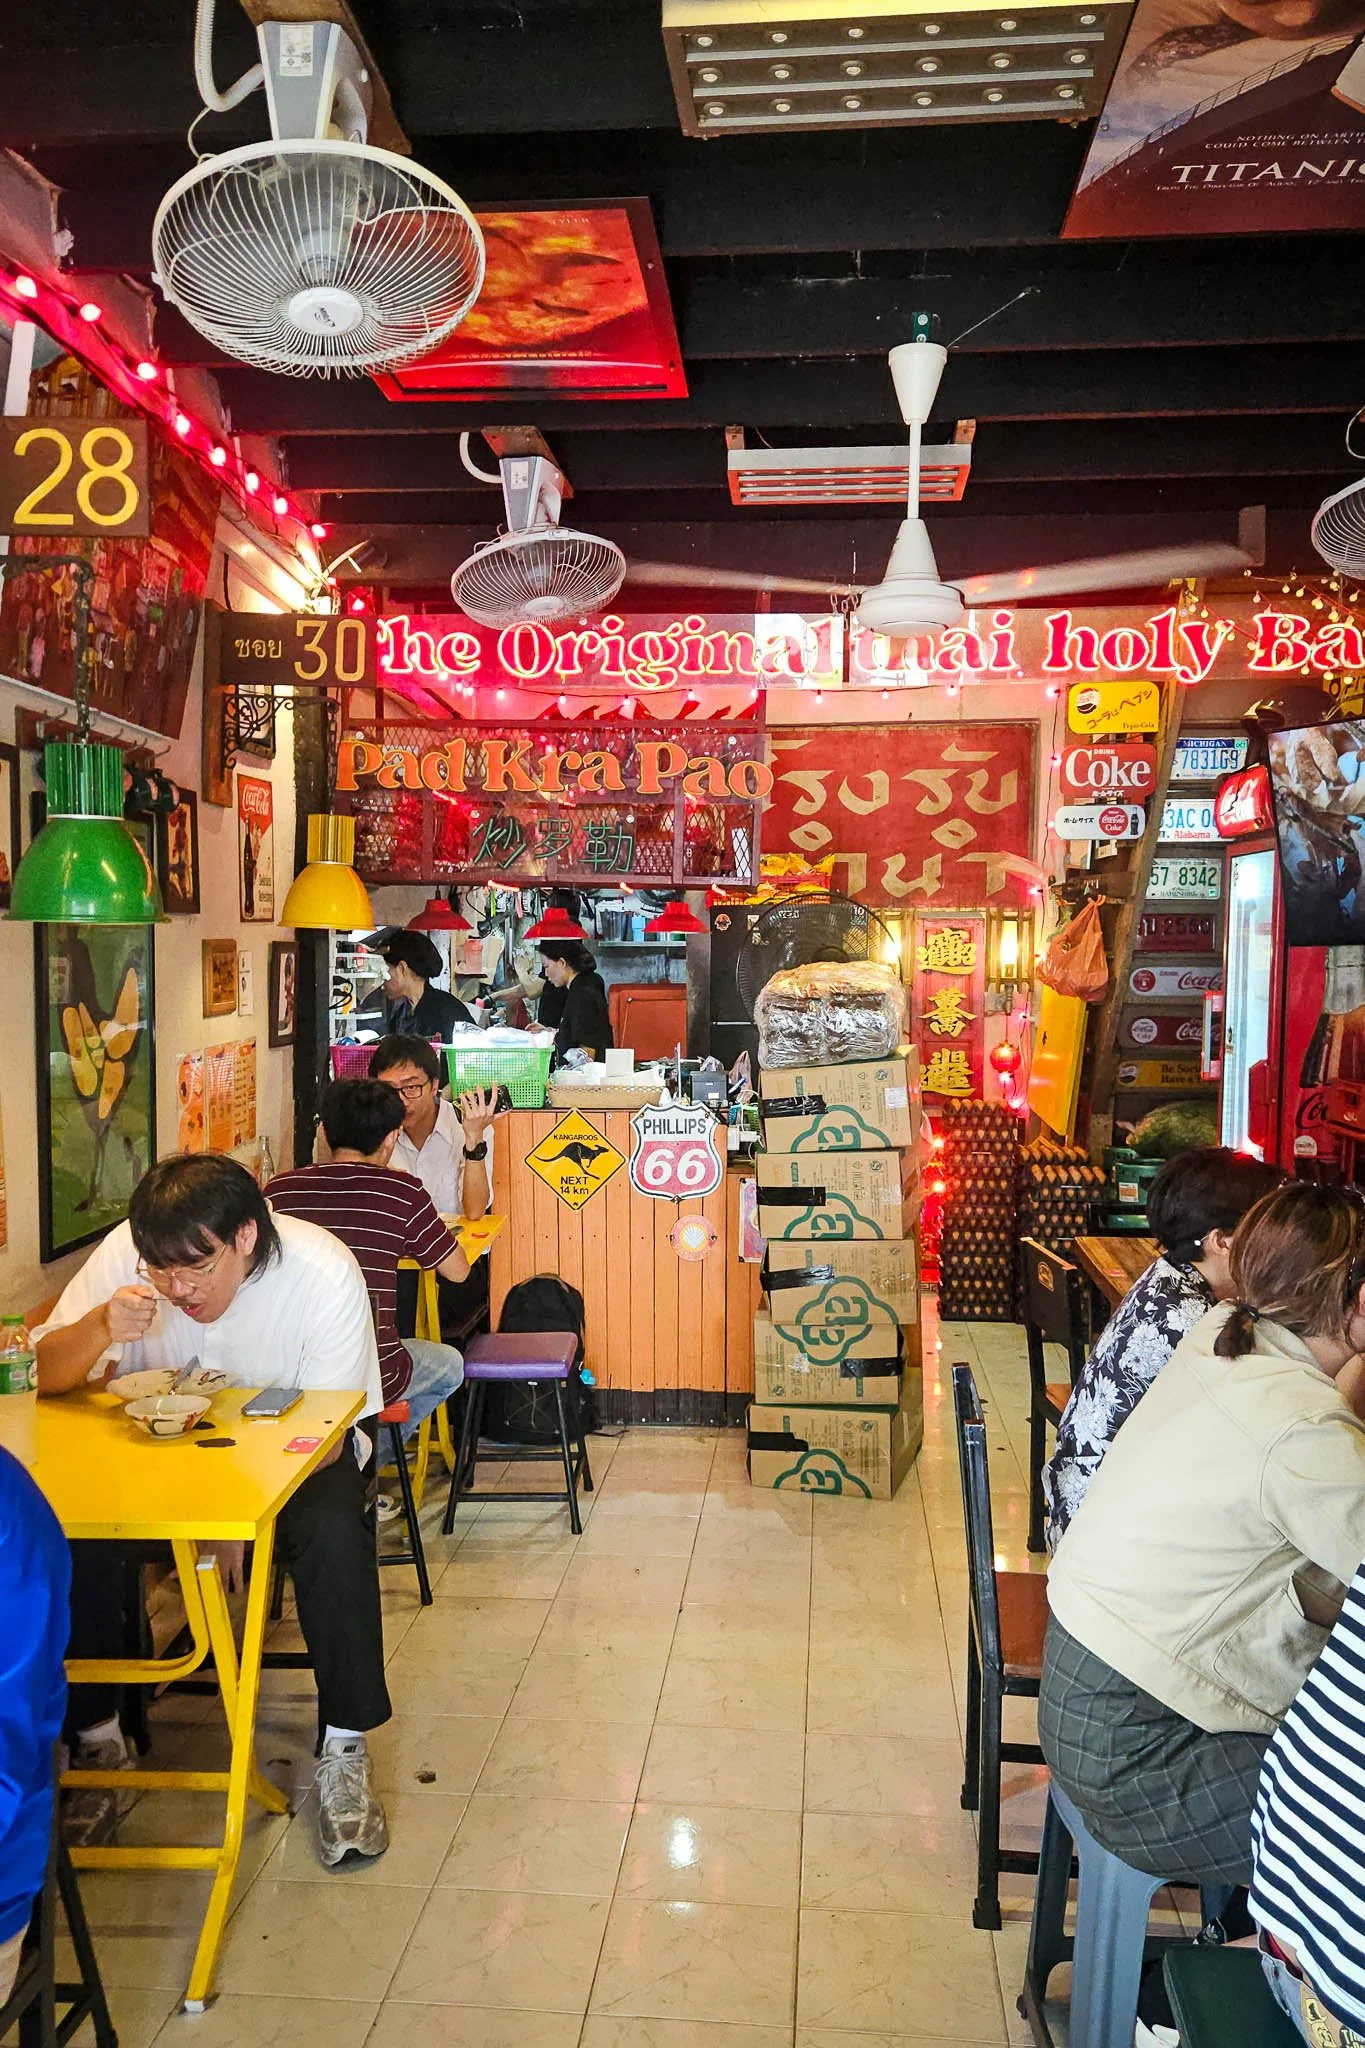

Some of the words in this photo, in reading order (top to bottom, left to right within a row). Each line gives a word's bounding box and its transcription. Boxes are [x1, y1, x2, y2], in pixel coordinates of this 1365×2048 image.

[13, 427, 139, 526] 28
[235, 638, 282, 659] ซอย
[294, 619, 366, 681] 30
[376, 614, 482, 675] he
[497, 614, 838, 689] Original
[1042, 607, 1235, 683] holy
[1182, 740, 1227, 748] MICHIGAN
[335, 738, 467, 792] Pad
[482, 740, 626, 792] Kra
[635, 742, 774, 799] Pao
[1065, 749, 1151, 787] Coke
[1160, 808, 1196, 829] 3AC
[472, 817, 633, 873] 炒罗勒
[1173, 830, 1211, 839] Alabama
[1179, 866, 1218, 887] 8342
[643, 1117, 707, 1135] PHILLIPS
[560, 1176, 589, 1185] NEXT
[643, 1148, 708, 1186] 66
[560, 1186, 571, 1195] 14
[573, 1186, 589, 1195] km
